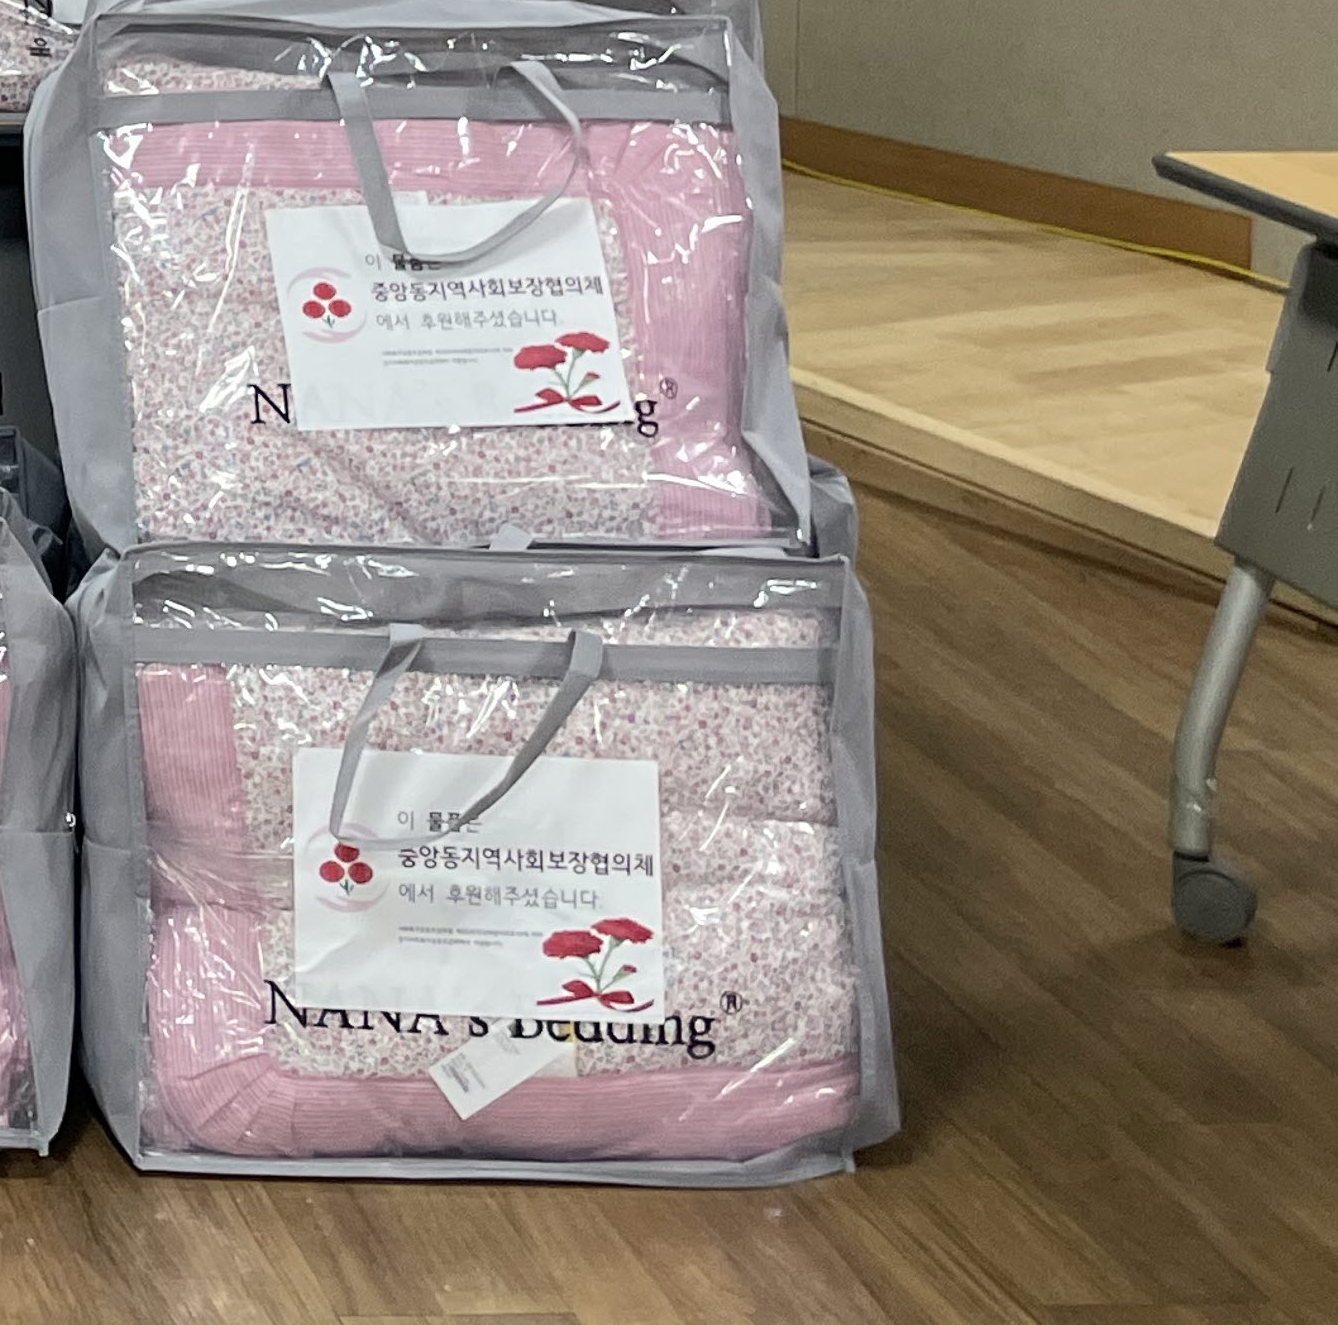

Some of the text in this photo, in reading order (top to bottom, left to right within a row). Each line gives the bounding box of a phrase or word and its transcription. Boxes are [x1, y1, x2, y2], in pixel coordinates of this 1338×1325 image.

[365, 253, 382, 272] 이
[371, 276, 605, 304] 중앙동지역사회보장협의체
[376, 313, 410, 331] 에서
[397, 810, 415, 832] 이
[398, 882, 434, 904] 에서
